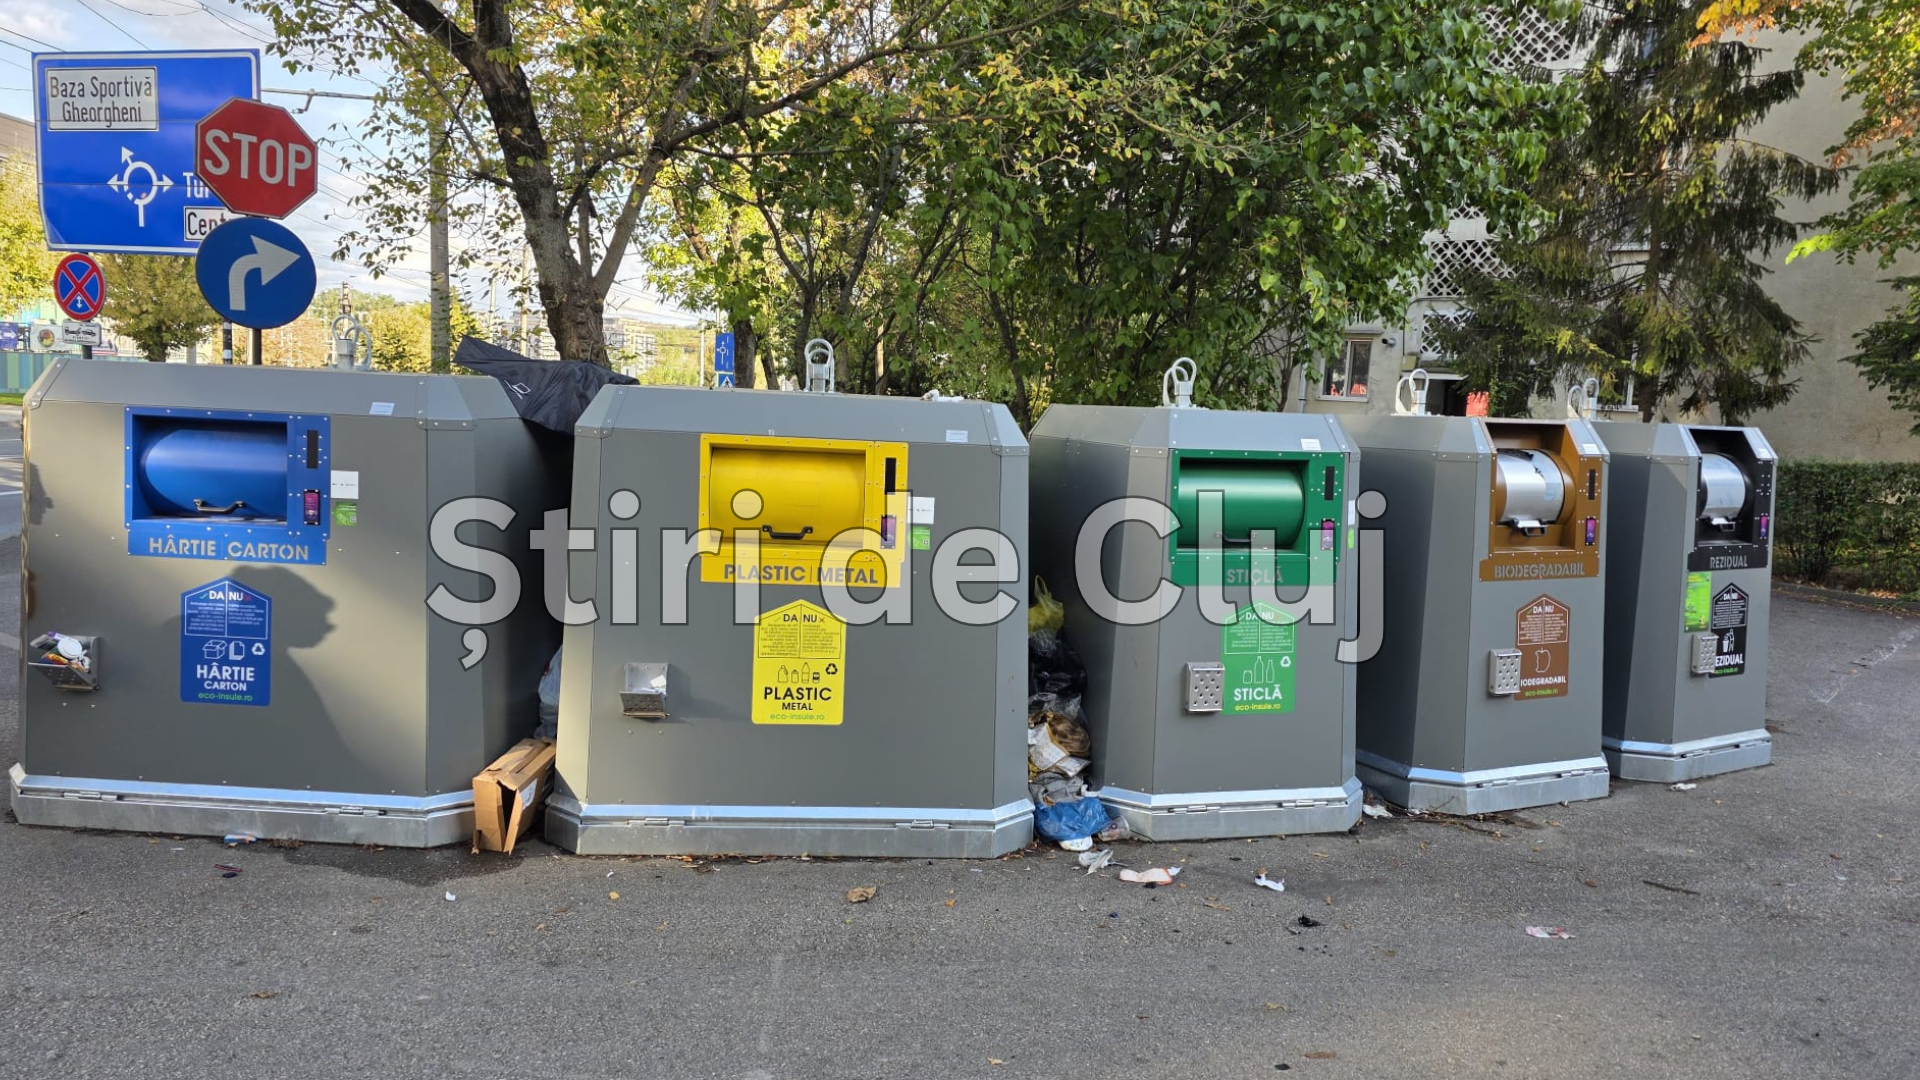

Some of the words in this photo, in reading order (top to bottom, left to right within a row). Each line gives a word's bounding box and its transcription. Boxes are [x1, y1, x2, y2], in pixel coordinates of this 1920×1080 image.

[49, 76, 85, 98] Baza
[90, 75, 152, 104] Sportivă
[62, 100, 142, 128] Gheorgheni
[203, 128, 313, 187] STOP
[149, 533, 217, 556] HÂRTIE
[227, 541, 309, 560] CARTON
[1710, 555, 1748, 569] REZIDUAL
[723, 563, 807, 582] PLASTIC
[816, 566, 878, 584] METAL
[1227, 565, 1284, 584] STICLĂ
[1494, 562, 1585, 578] BIODEGRADABIL
[208, 590, 225, 600] DA
[228, 591, 244, 601] NU
[1532, 606, 1543, 614] DA
[1545, 605, 1555, 613] NU
[783, 613, 799, 622] DA
[803, 614, 818, 623] NU
[1245, 611, 1259, 620] DA
[1261, 611, 1275, 620] NU
[1715, 654, 1744, 667] EZIDUAL
[196, 661, 255, 681] HÂRTIE
[203, 680, 247, 691] CARTON
[1520, 676, 1567, 687] IODEGRADABIL
[198, 692, 253, 702] eco-insule.ro
[763, 686, 832, 701] PLASTIC
[1233, 684, 1283, 701] STICLĂ
[782, 702, 814, 711] METAL
[770, 713, 825, 721] eco-insule.ro
